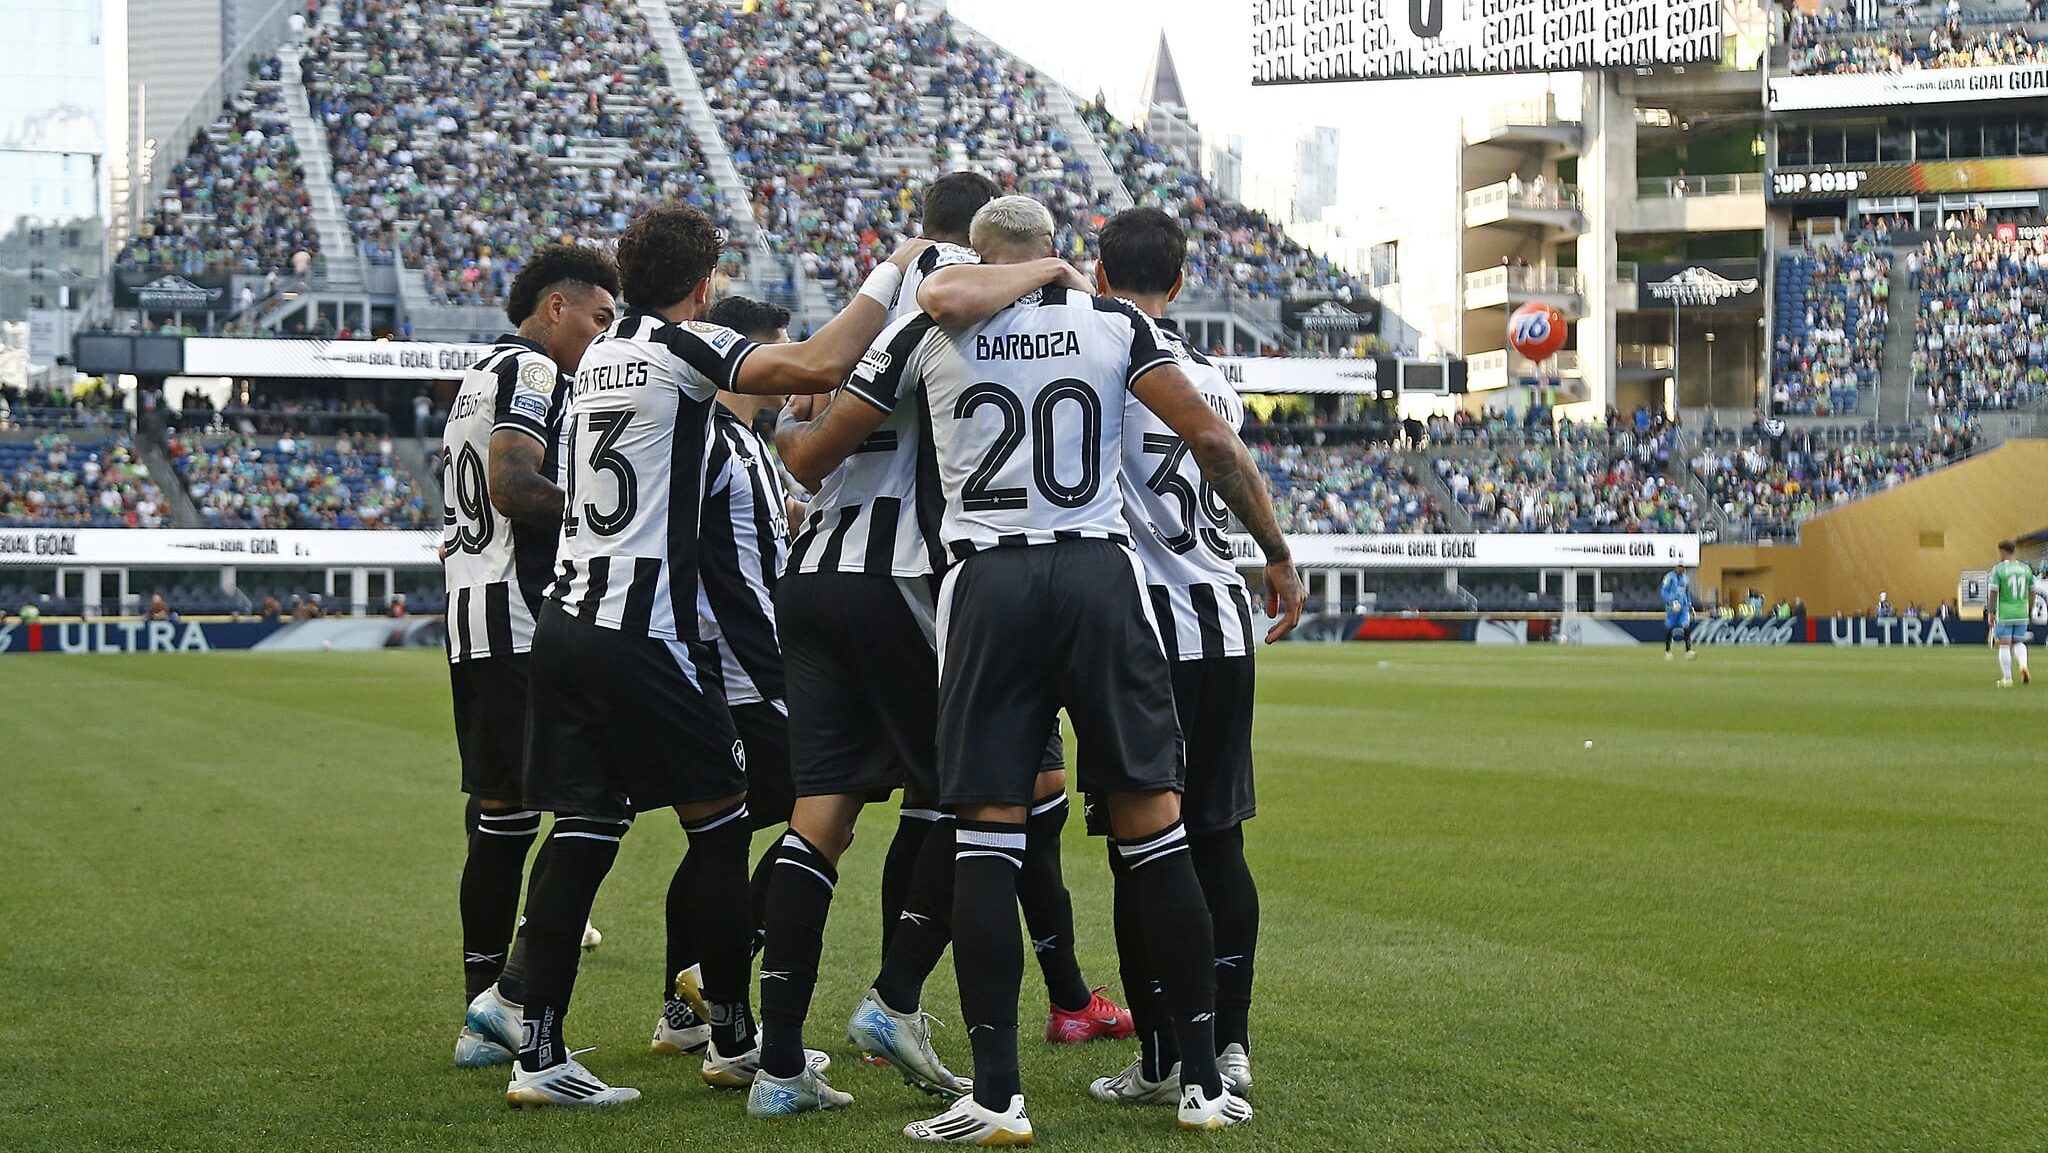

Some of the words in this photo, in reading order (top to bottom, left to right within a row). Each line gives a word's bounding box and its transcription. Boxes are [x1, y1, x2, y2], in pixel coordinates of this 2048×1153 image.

[1304, 20, 1354, 57] GOAL
[1483, 10, 1534, 49] GOAL
[1543, 7, 1596, 46] GOAL
[1605, 3, 1658, 43] GOAL
[1304, 50, 1359, 82] GOAL
[1363, 48, 1418, 80] GOAL
[1423, 45, 1480, 76] GOAL
[1483, 42, 1538, 72] GOAL
[1543, 38, 1599, 70] GOAL
[1605, 35, 1661, 66] GOAL
[1970, 73, 2004, 90] GOAL
[976, 330, 1081, 361] BARBOZA
[592, 361, 649, 392] TELLES
[953, 378, 1102, 512] 20
[35, 534, 76, 556] GOAL
[1441, 537, 1476, 558] GOAL
[59, 621, 210, 653] ULTRA
[1690, 616, 1799, 645] Michelob
[1831, 616, 1951, 646] ULTRA
